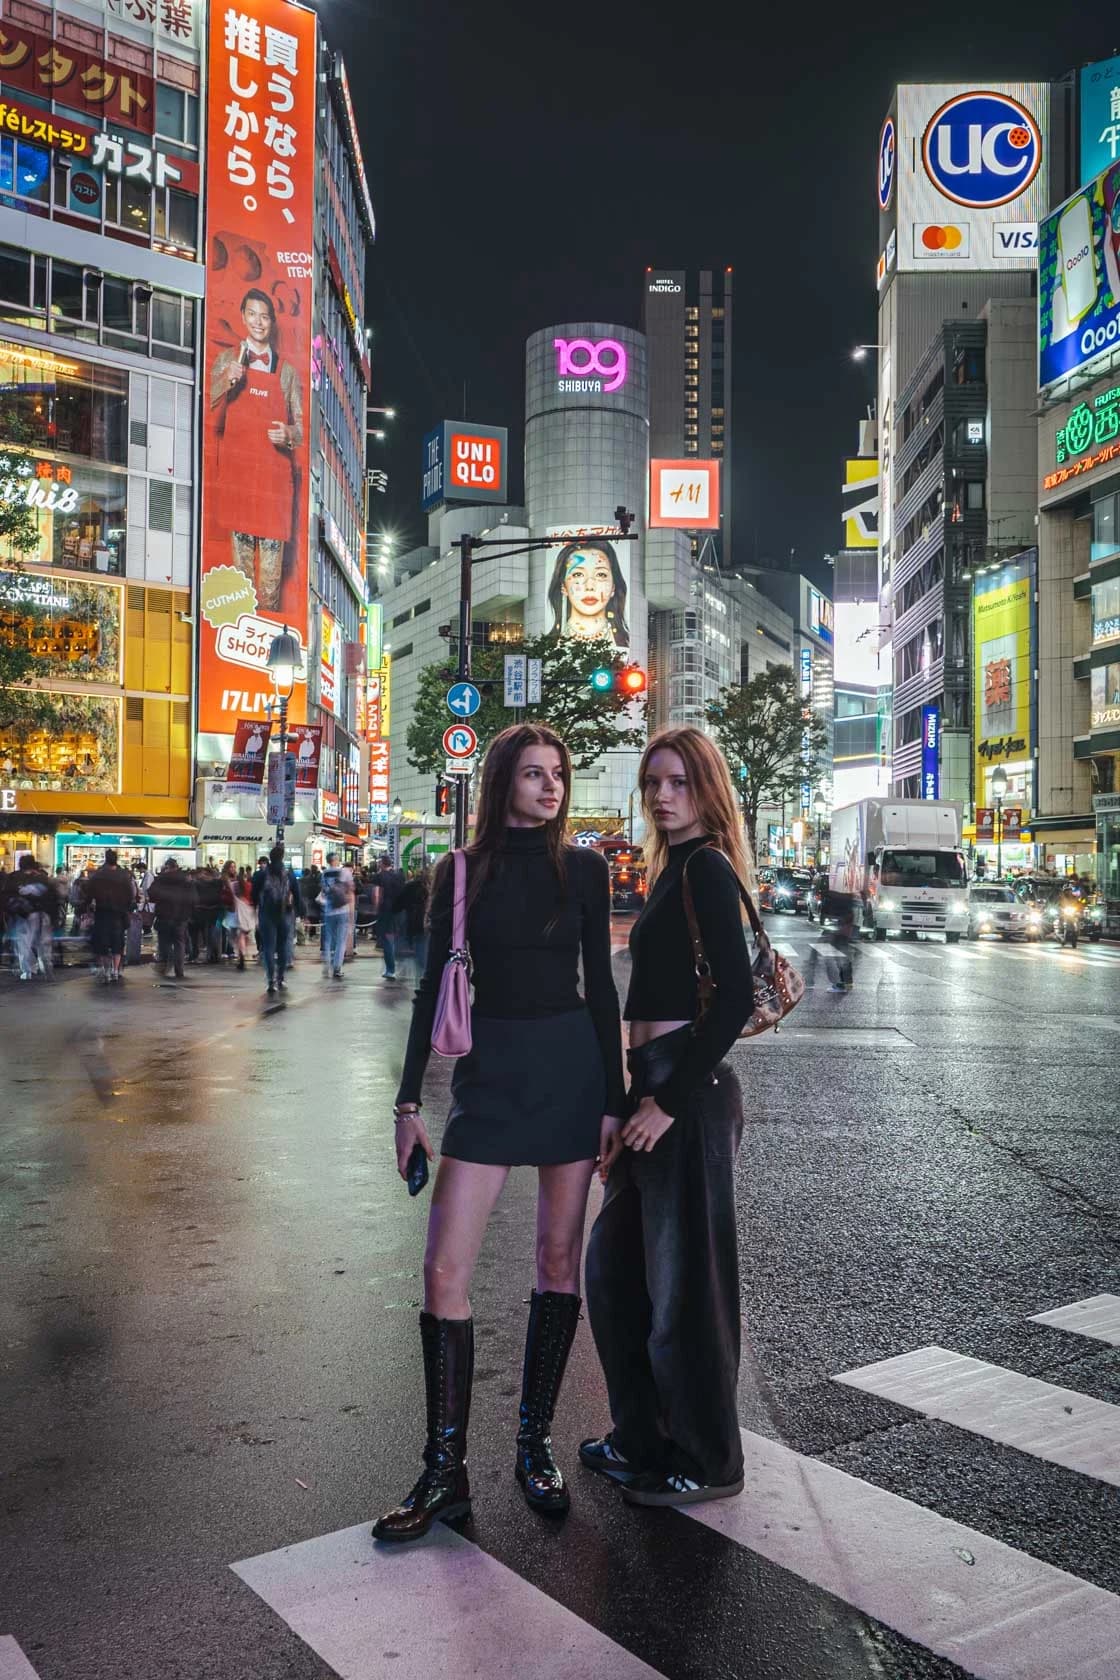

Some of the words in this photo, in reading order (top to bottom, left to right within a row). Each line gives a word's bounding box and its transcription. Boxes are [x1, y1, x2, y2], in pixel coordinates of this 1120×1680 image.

[224, 8, 261, 212] 推しから。
[264, 25, 299, 224] 買うなら、
[92, 133, 181, 188] ガスト
[938, 123, 1029, 176] UC
[997, 232, 1039, 249] VIS
[1066, 246, 1089, 271] Qoo10
[649, 285, 681, 293] INDIGO
[554, 338, 628, 393] 109
[558, 380, 601, 393] SHIBUYA
[428, 436, 439, 469] THE
[457, 440, 492, 462] UNI
[456, 462, 495, 483] QLO
[513, 659, 523, 702] 渋谷駅前
[928, 713, 936, 748] MIZUHO
